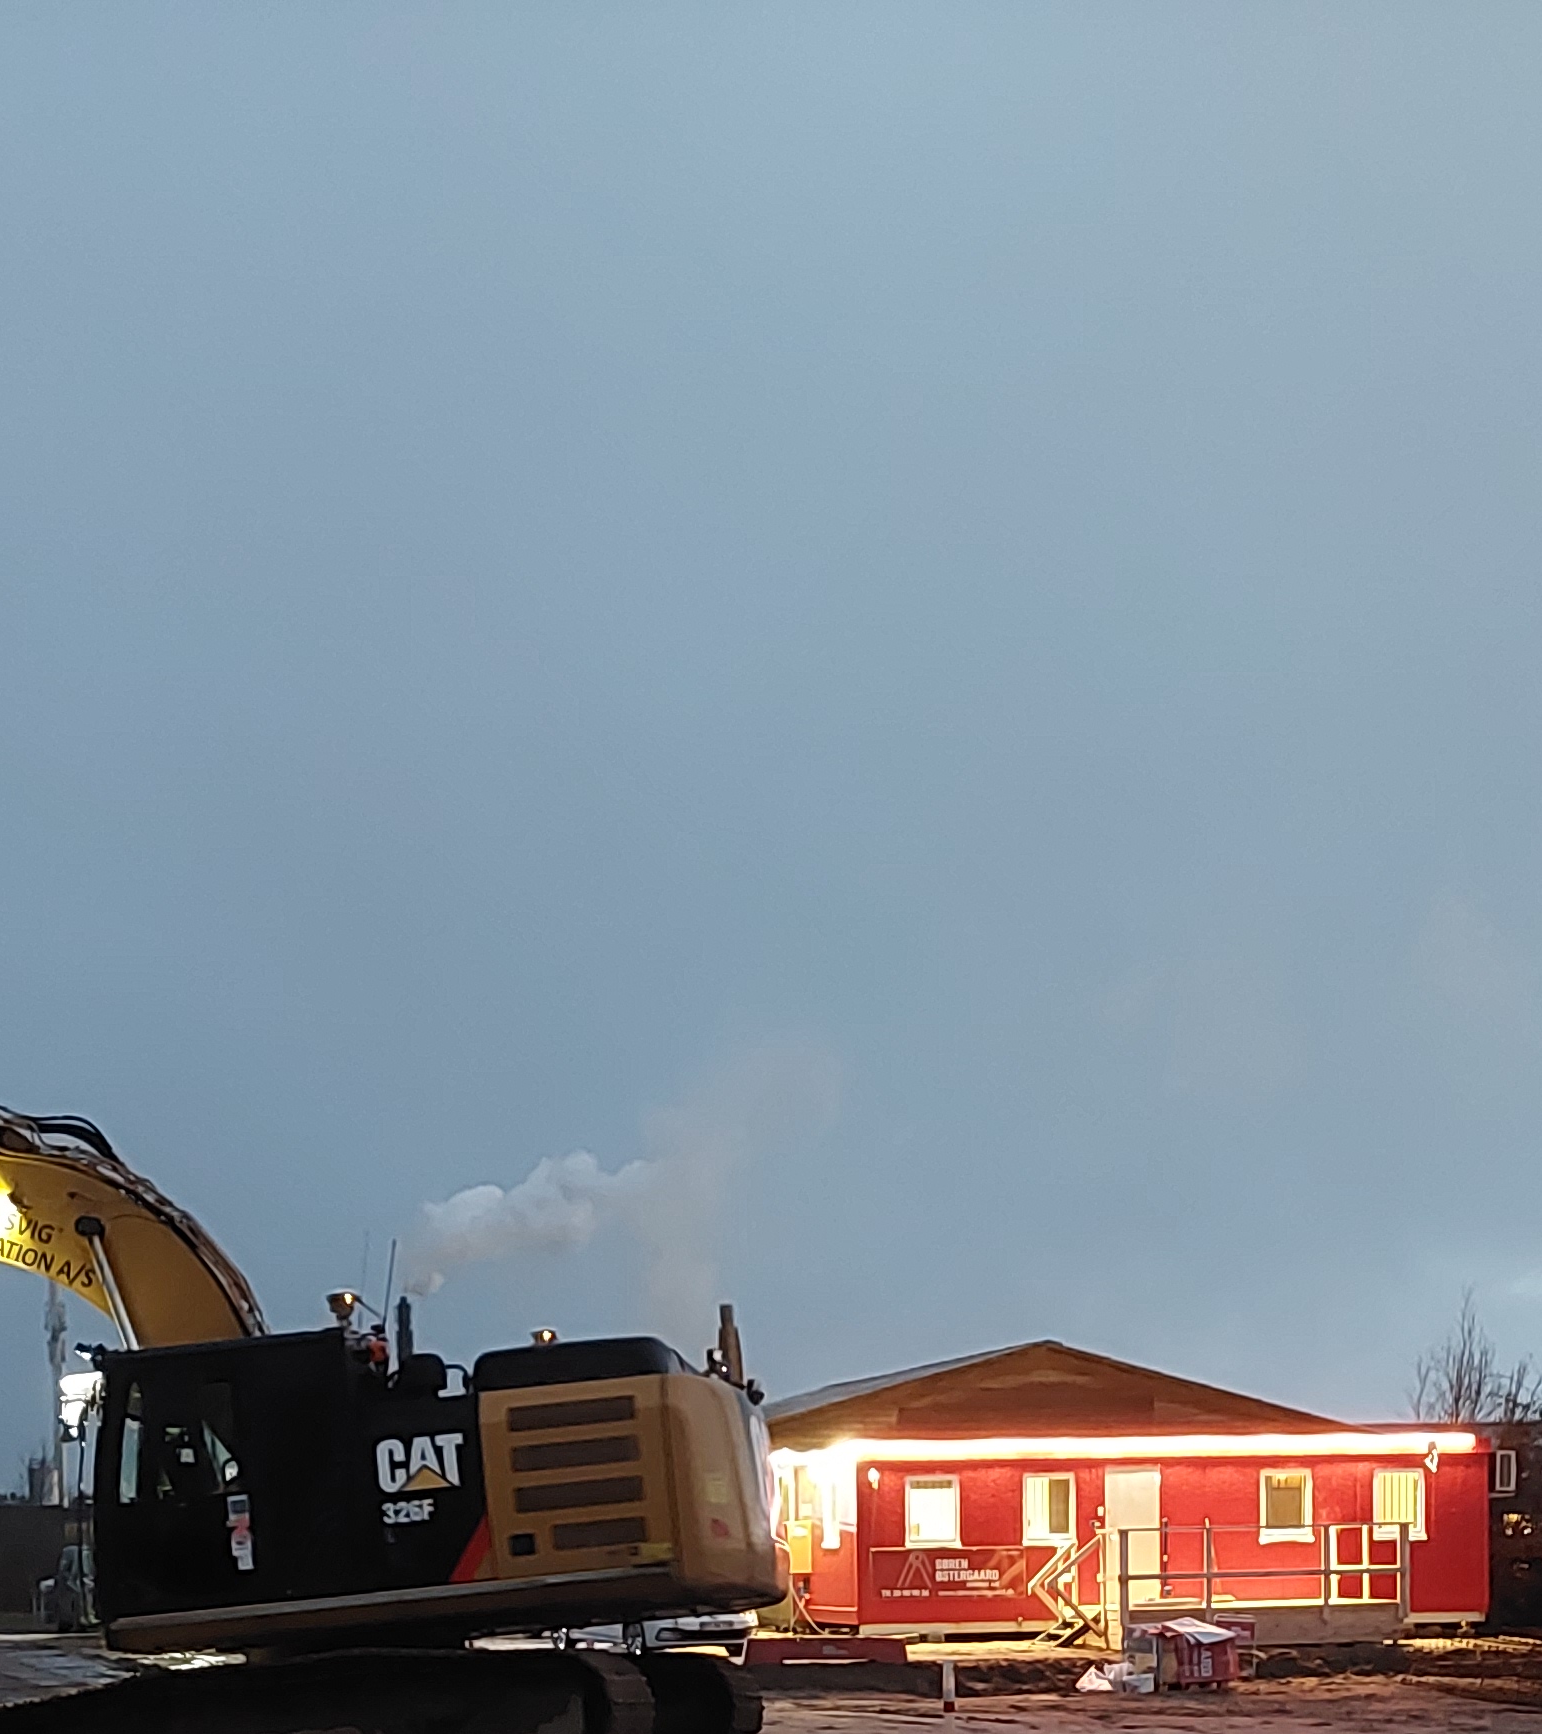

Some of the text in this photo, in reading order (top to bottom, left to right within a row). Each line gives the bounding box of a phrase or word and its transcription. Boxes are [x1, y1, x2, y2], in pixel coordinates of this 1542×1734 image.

[56, 1259, 97, 1288] A/S
[376, 1432, 464, 1493] CAT
[381, 1498, 435, 1524] 326F
